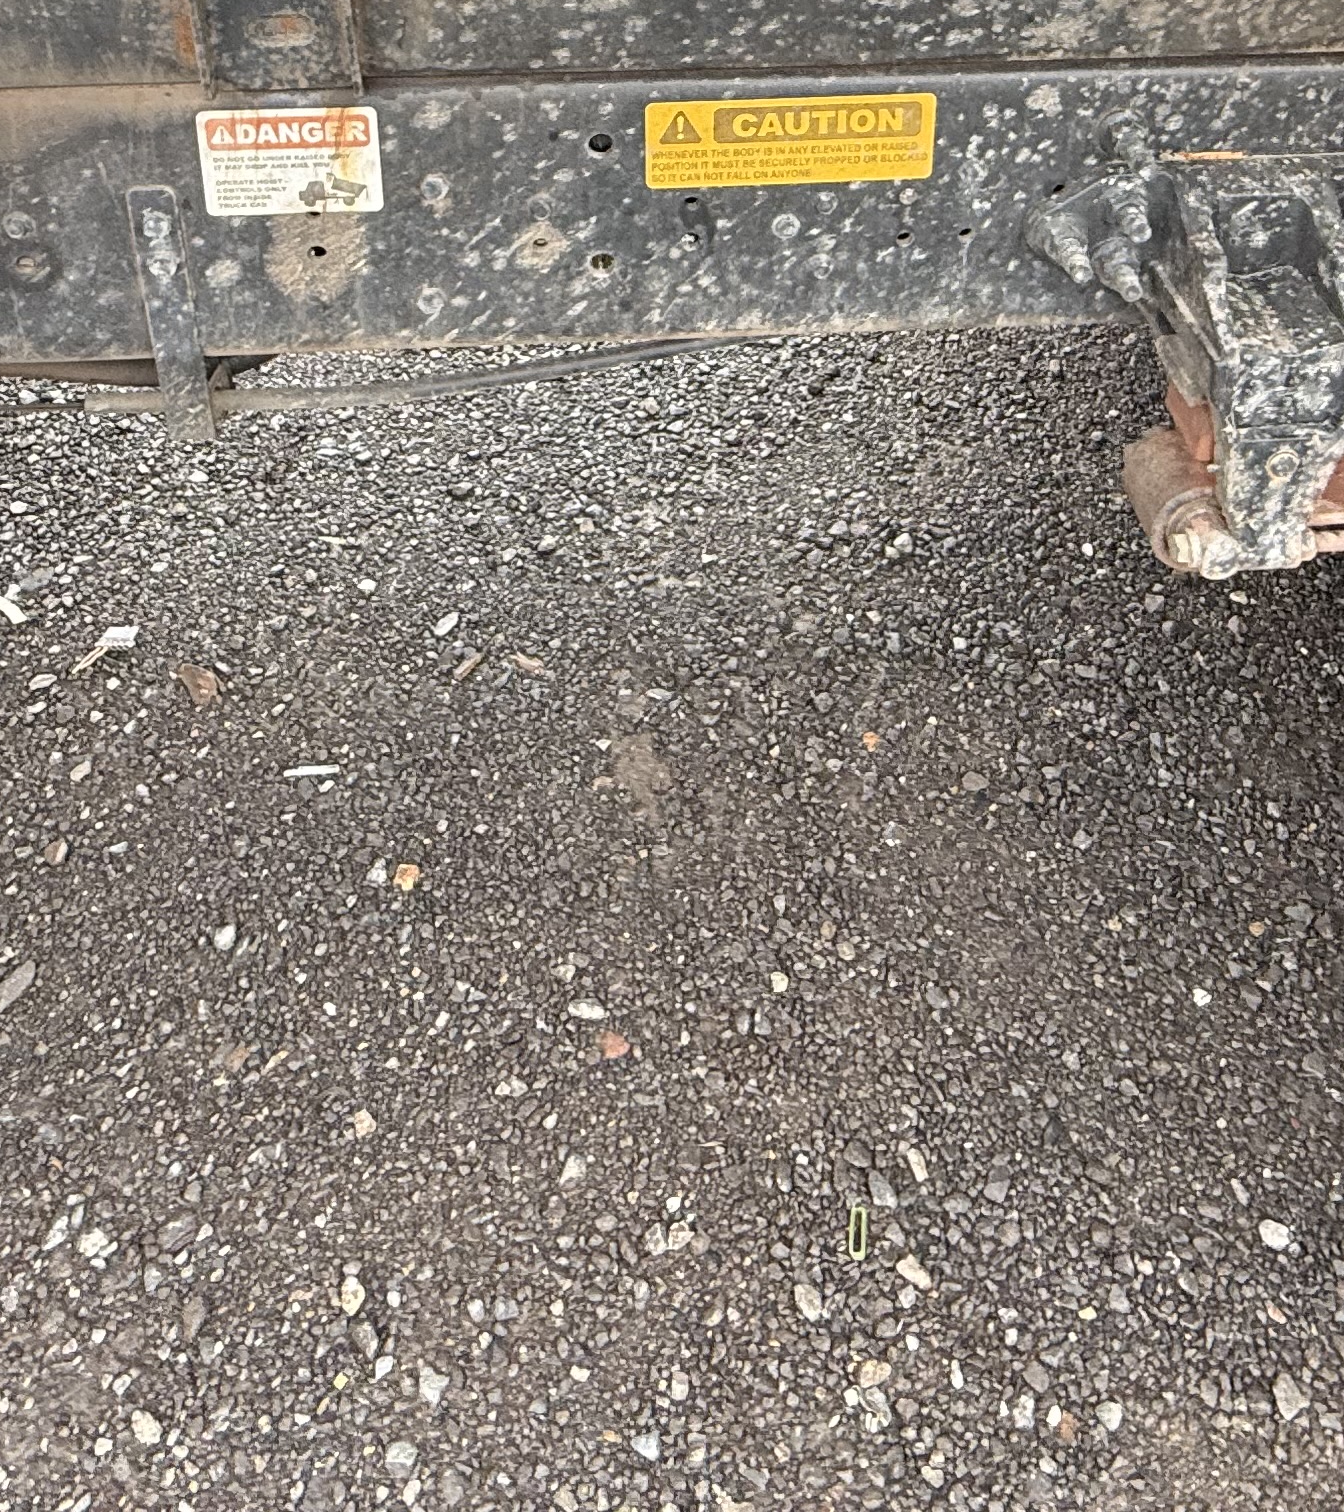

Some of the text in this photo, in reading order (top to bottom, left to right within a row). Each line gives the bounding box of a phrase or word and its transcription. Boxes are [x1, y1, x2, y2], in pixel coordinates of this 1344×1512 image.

[235, 120, 367, 144] DANGER
[732, 107, 904, 137] CAUTION
[651, 149, 708, 160] WHENEVER
[711, 149, 730, 157] THE
[733, 147, 760, 157] BODY
[764, 147, 773, 156] IS
[788, 145, 808, 154] ANY
[811, 143, 861, 154] ELEVATED
[864, 143, 878, 153] OR
[881, 142, 918, 151] RAISED
[651, 152, 928, 172] POSITION IT MUST BE SECURELY PROPPED OR BLOCKED
[679, 173, 700, 182] CAN
[704, 171, 723, 181] NOT
[726, 171, 750, 180] FALL
[753, 170, 768, 179] ON
[770, 169, 811, 179] ANYONE
